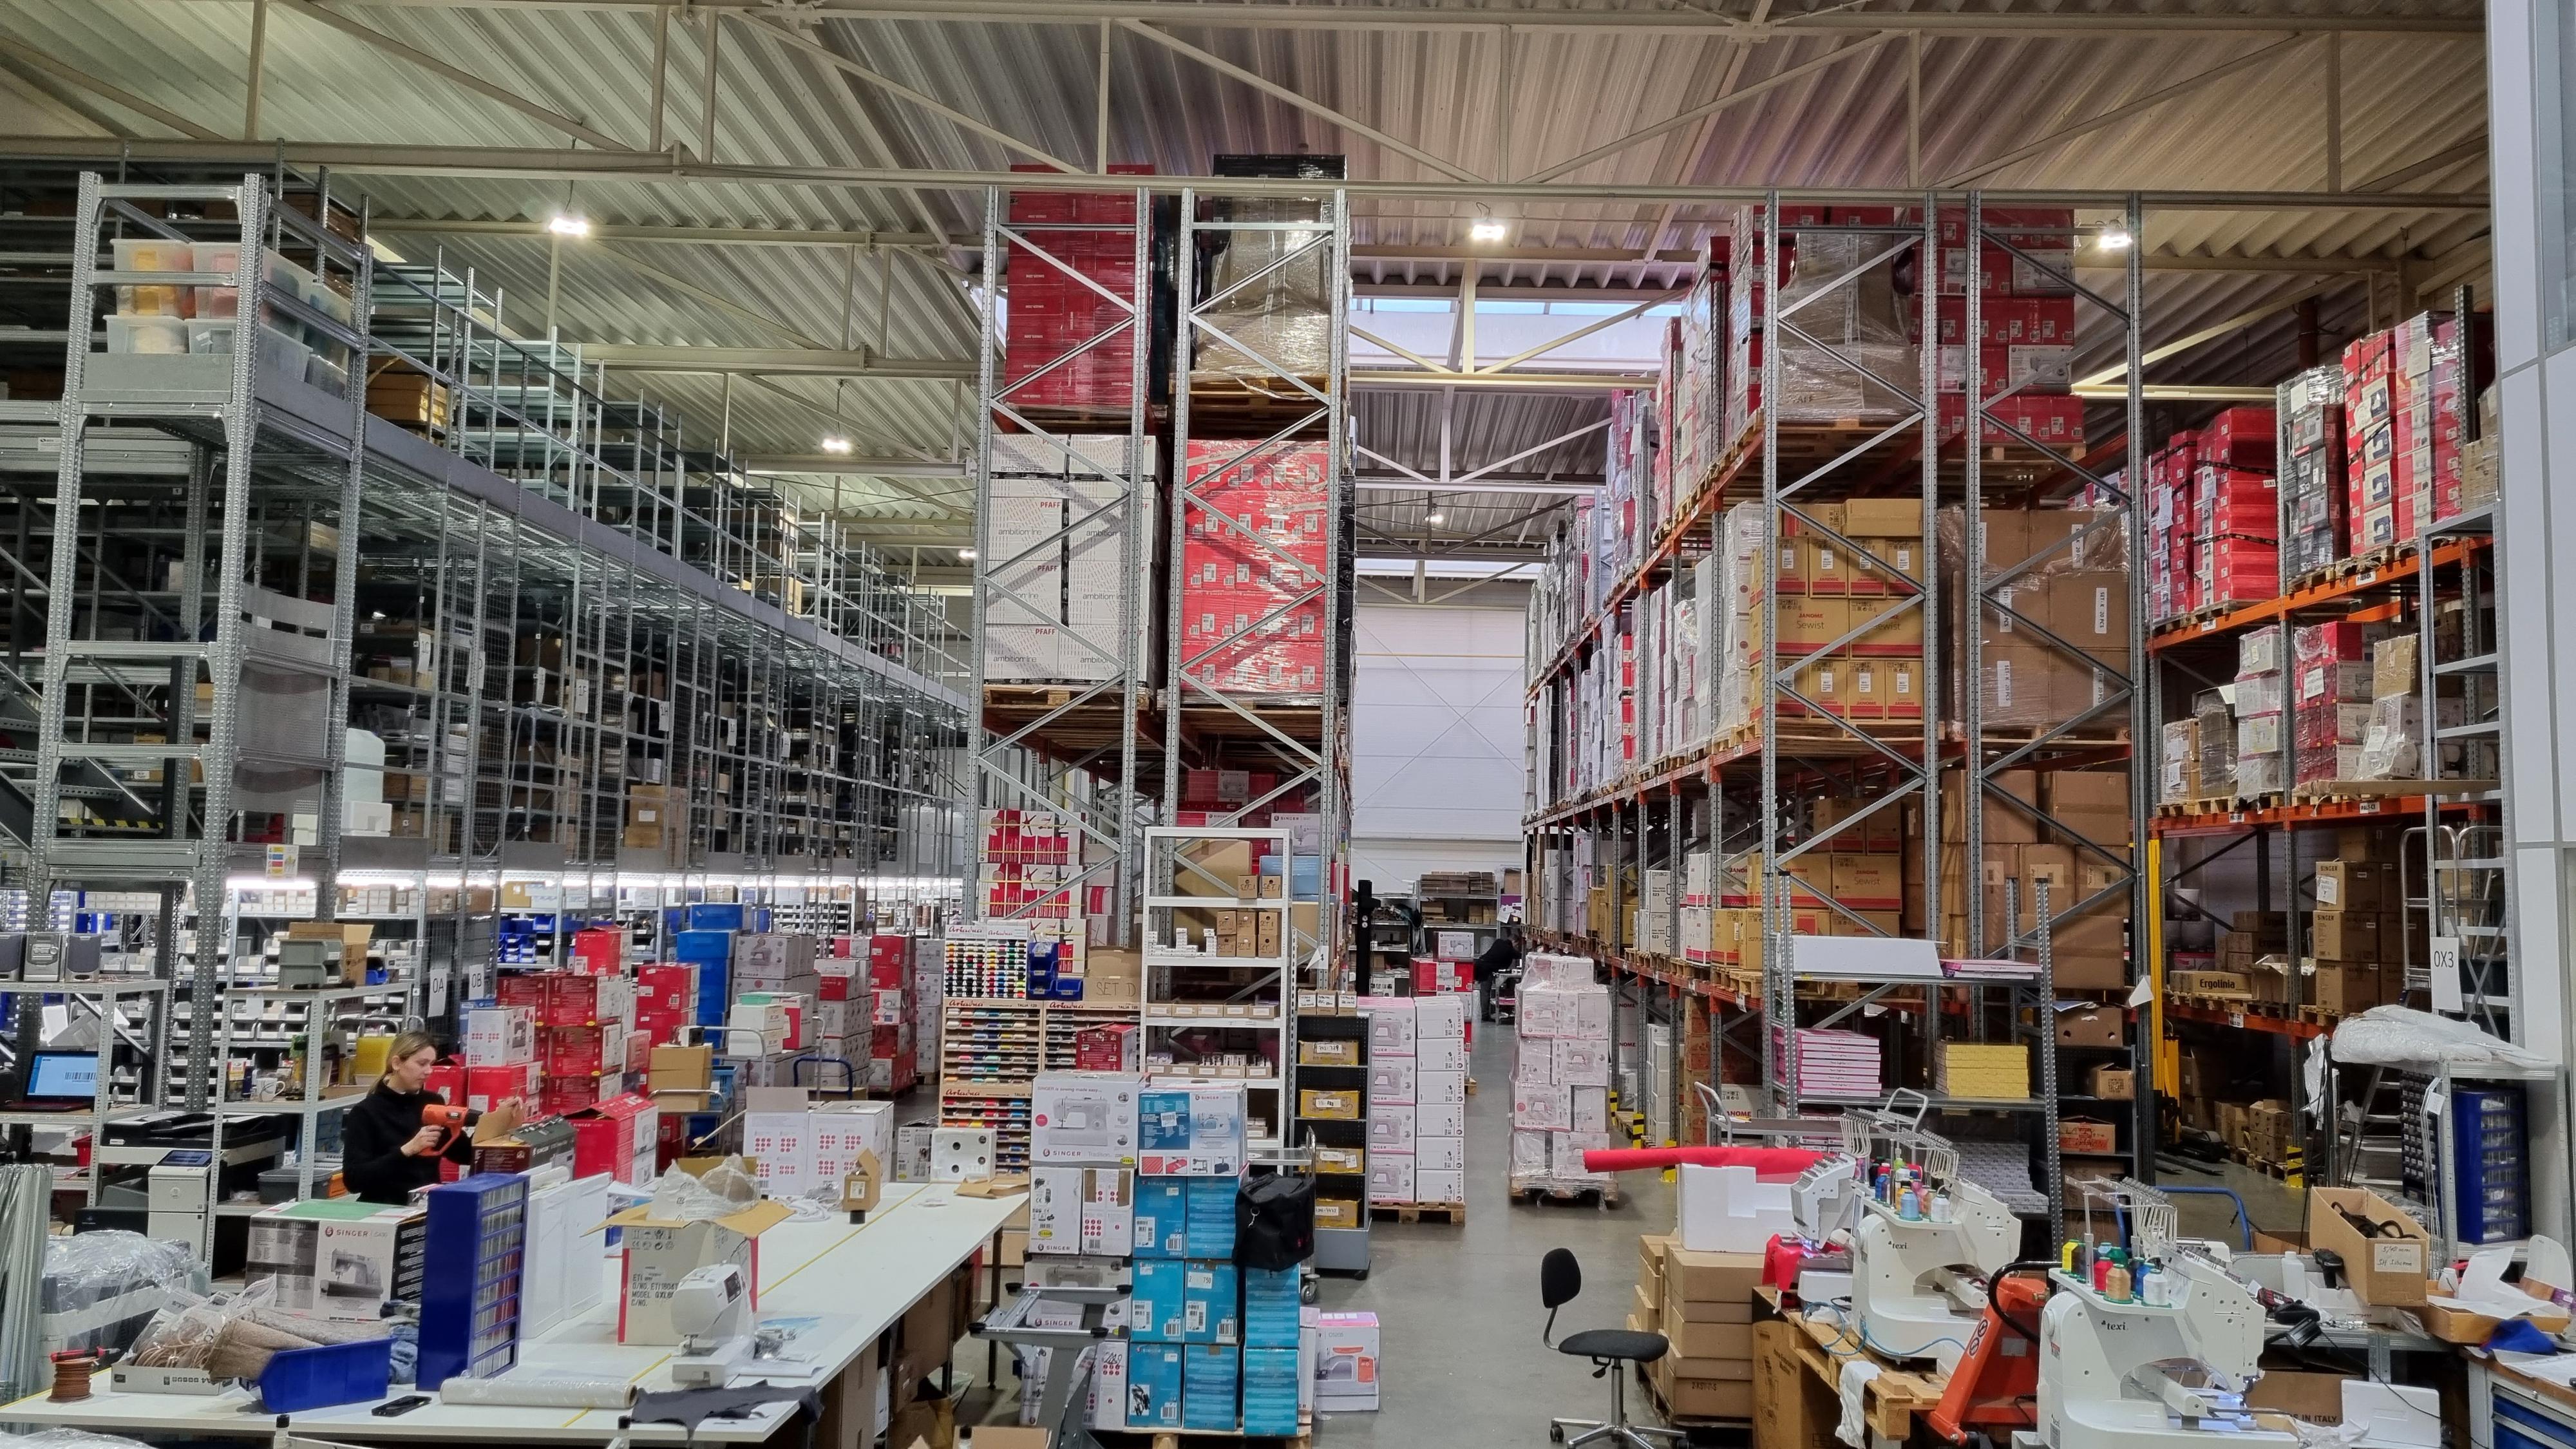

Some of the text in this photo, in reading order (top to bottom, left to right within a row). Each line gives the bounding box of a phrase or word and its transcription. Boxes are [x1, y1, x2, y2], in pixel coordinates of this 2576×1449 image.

[1797, 621, 1824, 629] Sewist
[2200, 979, 2235, 989] Ergolinia
[1096, 982, 1136, 997] SET D
[2107, 1322, 2125, 1331] texi
